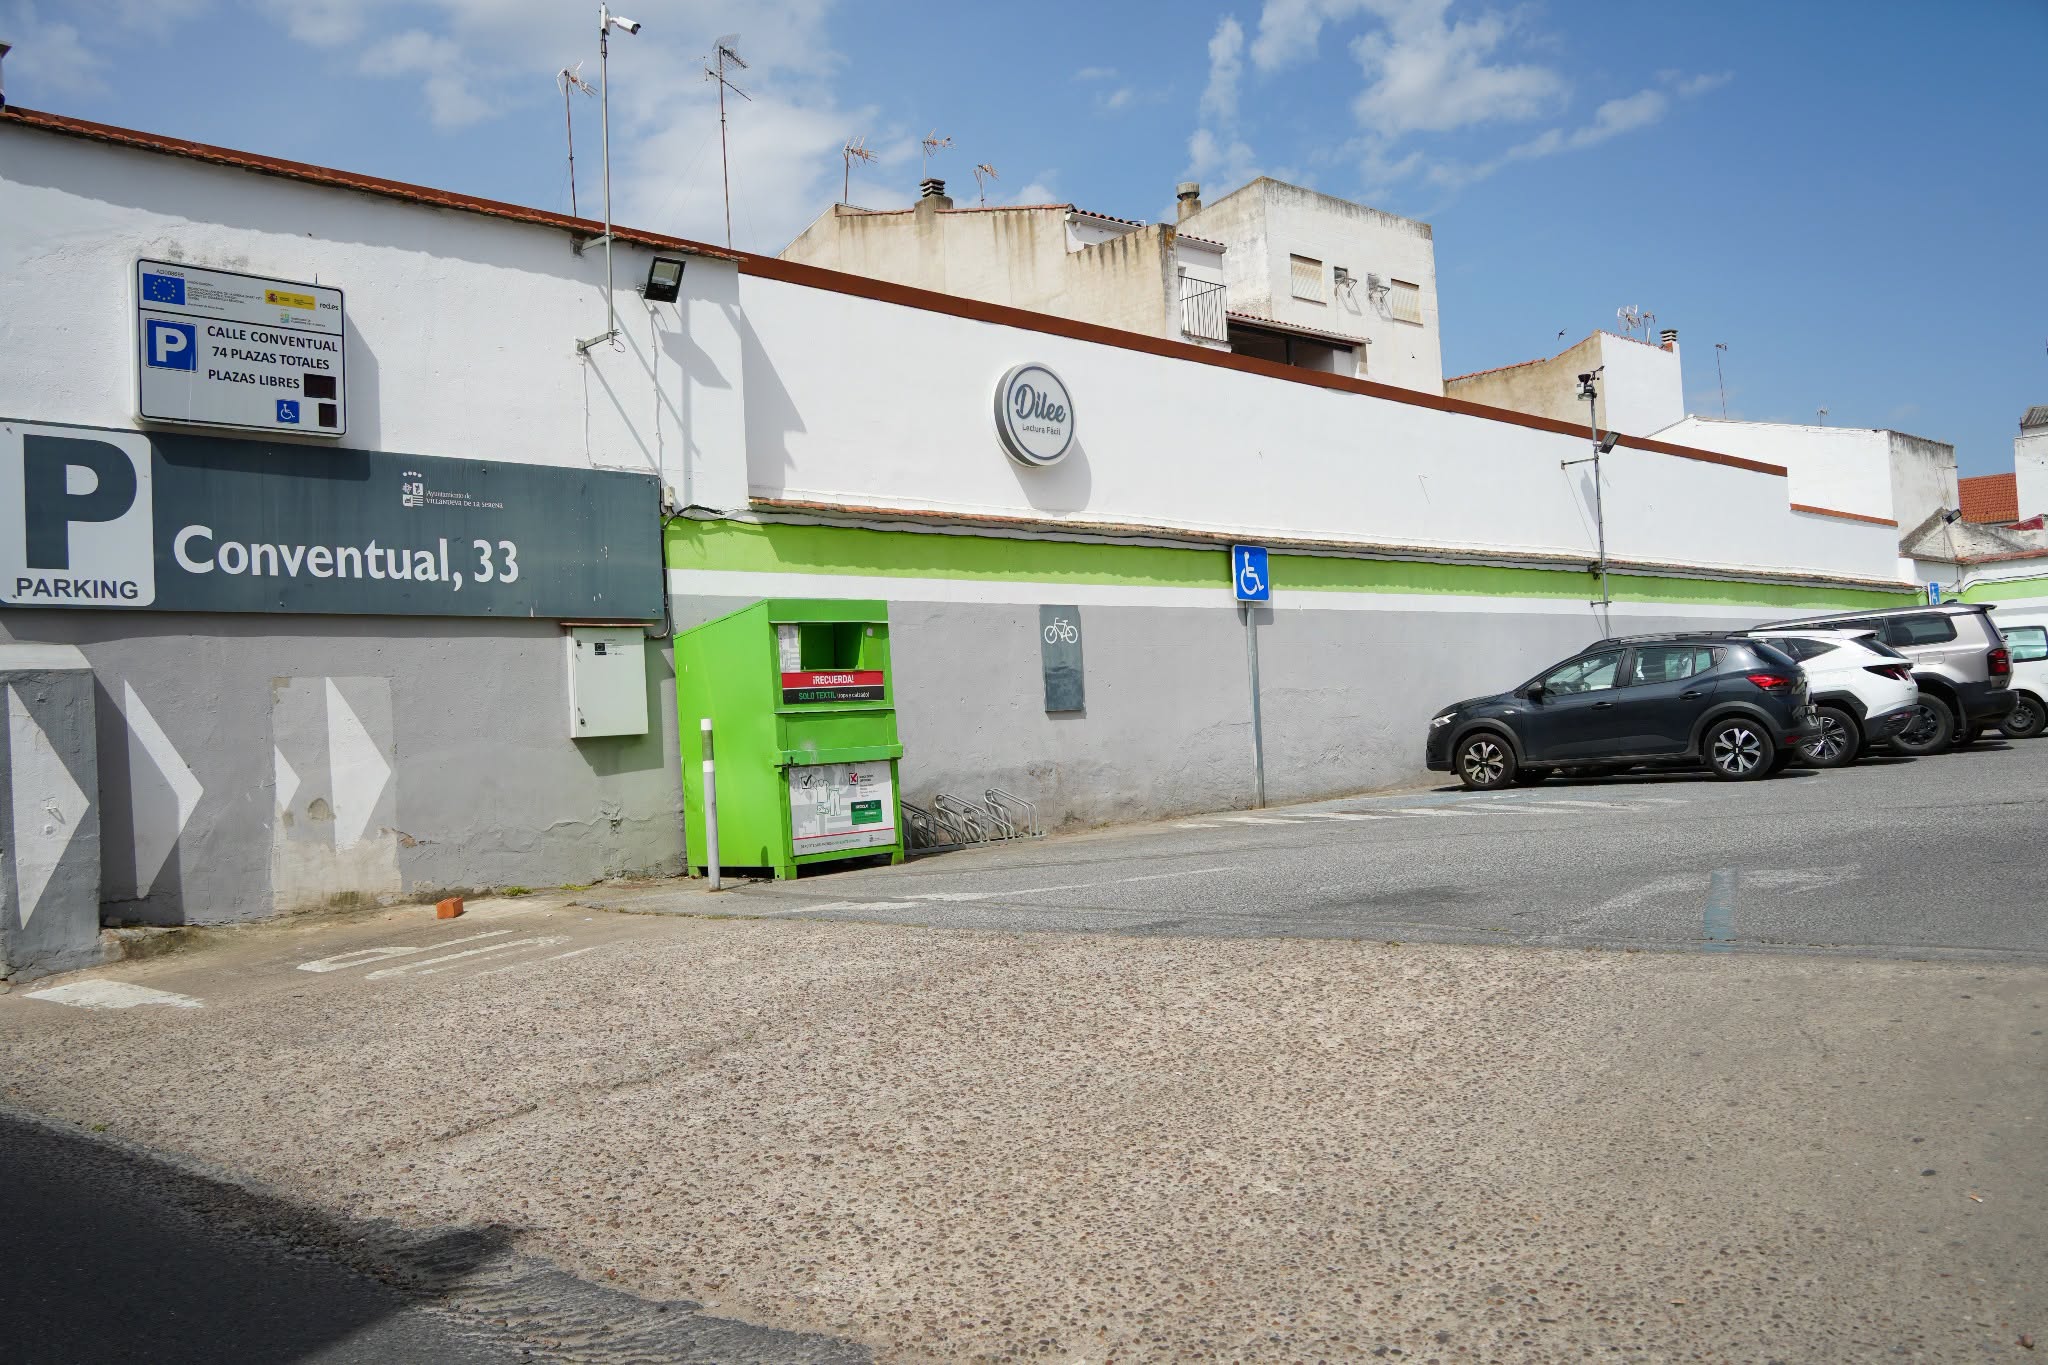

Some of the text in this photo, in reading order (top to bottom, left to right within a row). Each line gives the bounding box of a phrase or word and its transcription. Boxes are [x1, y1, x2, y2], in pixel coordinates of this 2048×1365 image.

[155, 326, 188, 362] P
[207, 325, 338, 352] CALLE CONVENTUAL
[212, 346, 330, 370] 74 PLAZAS TOTALES
[208, 369, 300, 389] PLAZAS LIBRES
[1015, 384, 1066, 422] Dilee
[1022, 424, 1045, 434] Lectura
[23, 433, 137, 570] P
[173, 525, 519, 592] Conventual, 33
[16, 577, 139, 600] PARKING
[812, 674, 855, 685] ¡RECUERDA!
[798, 692, 815, 700] SOLO
[816, 691, 837, 699] TEXTIL
